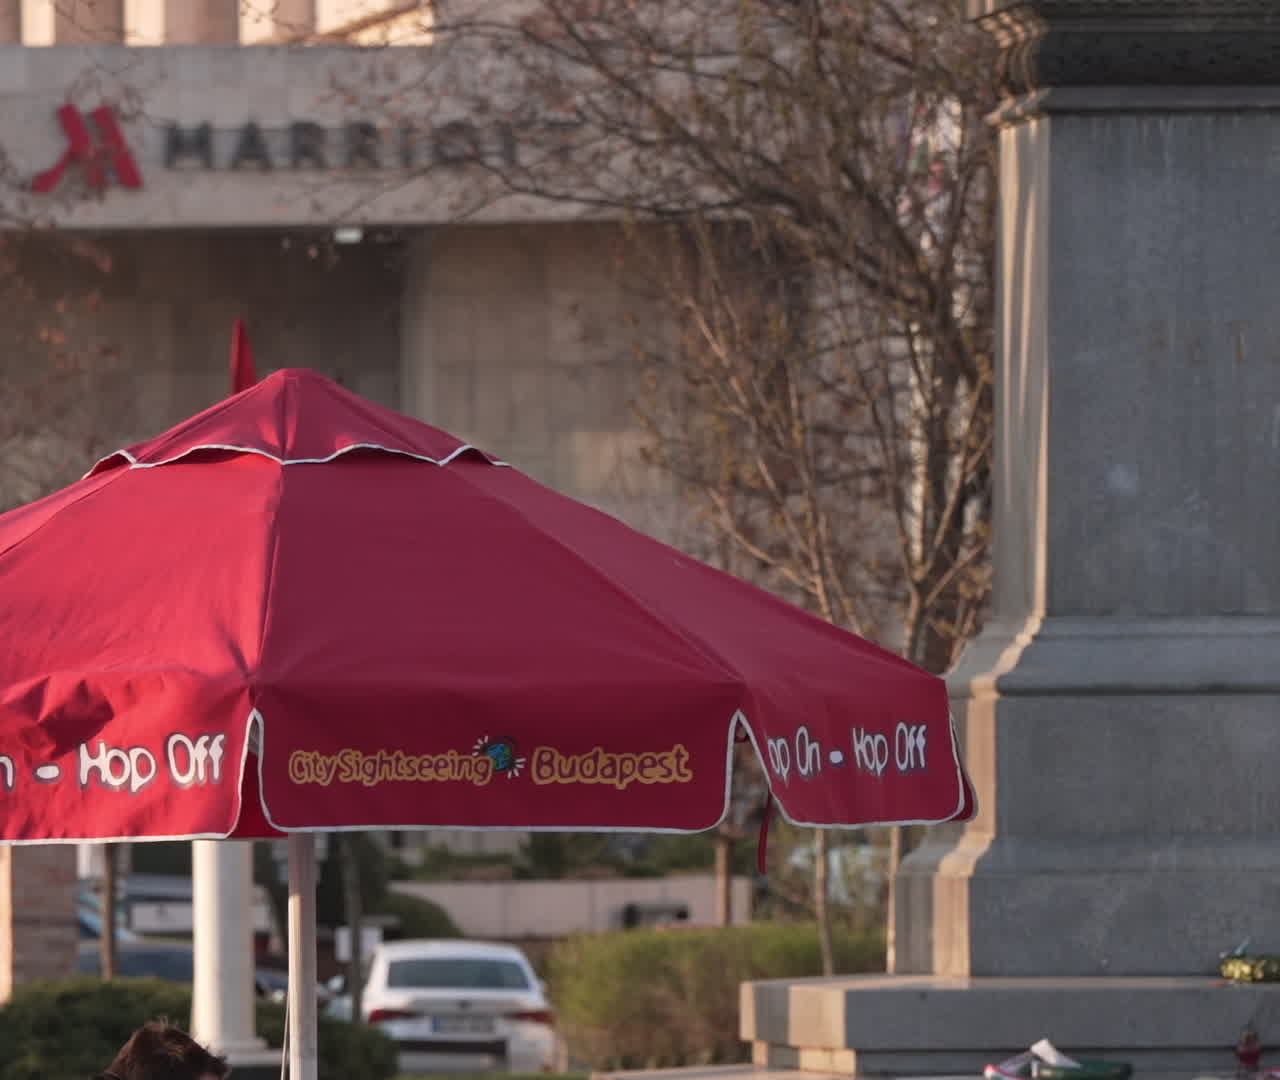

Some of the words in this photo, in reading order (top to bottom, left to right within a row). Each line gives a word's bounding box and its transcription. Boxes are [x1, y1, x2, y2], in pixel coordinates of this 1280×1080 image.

[79, 742, 156, 793] Hop
[168, 733, 225, 785] Off
[531, 744, 693, 790] Budapest
[796, 725, 821, 776] On
[851, 726, 889, 778] Hop
[895, 721, 927, 772] Off
